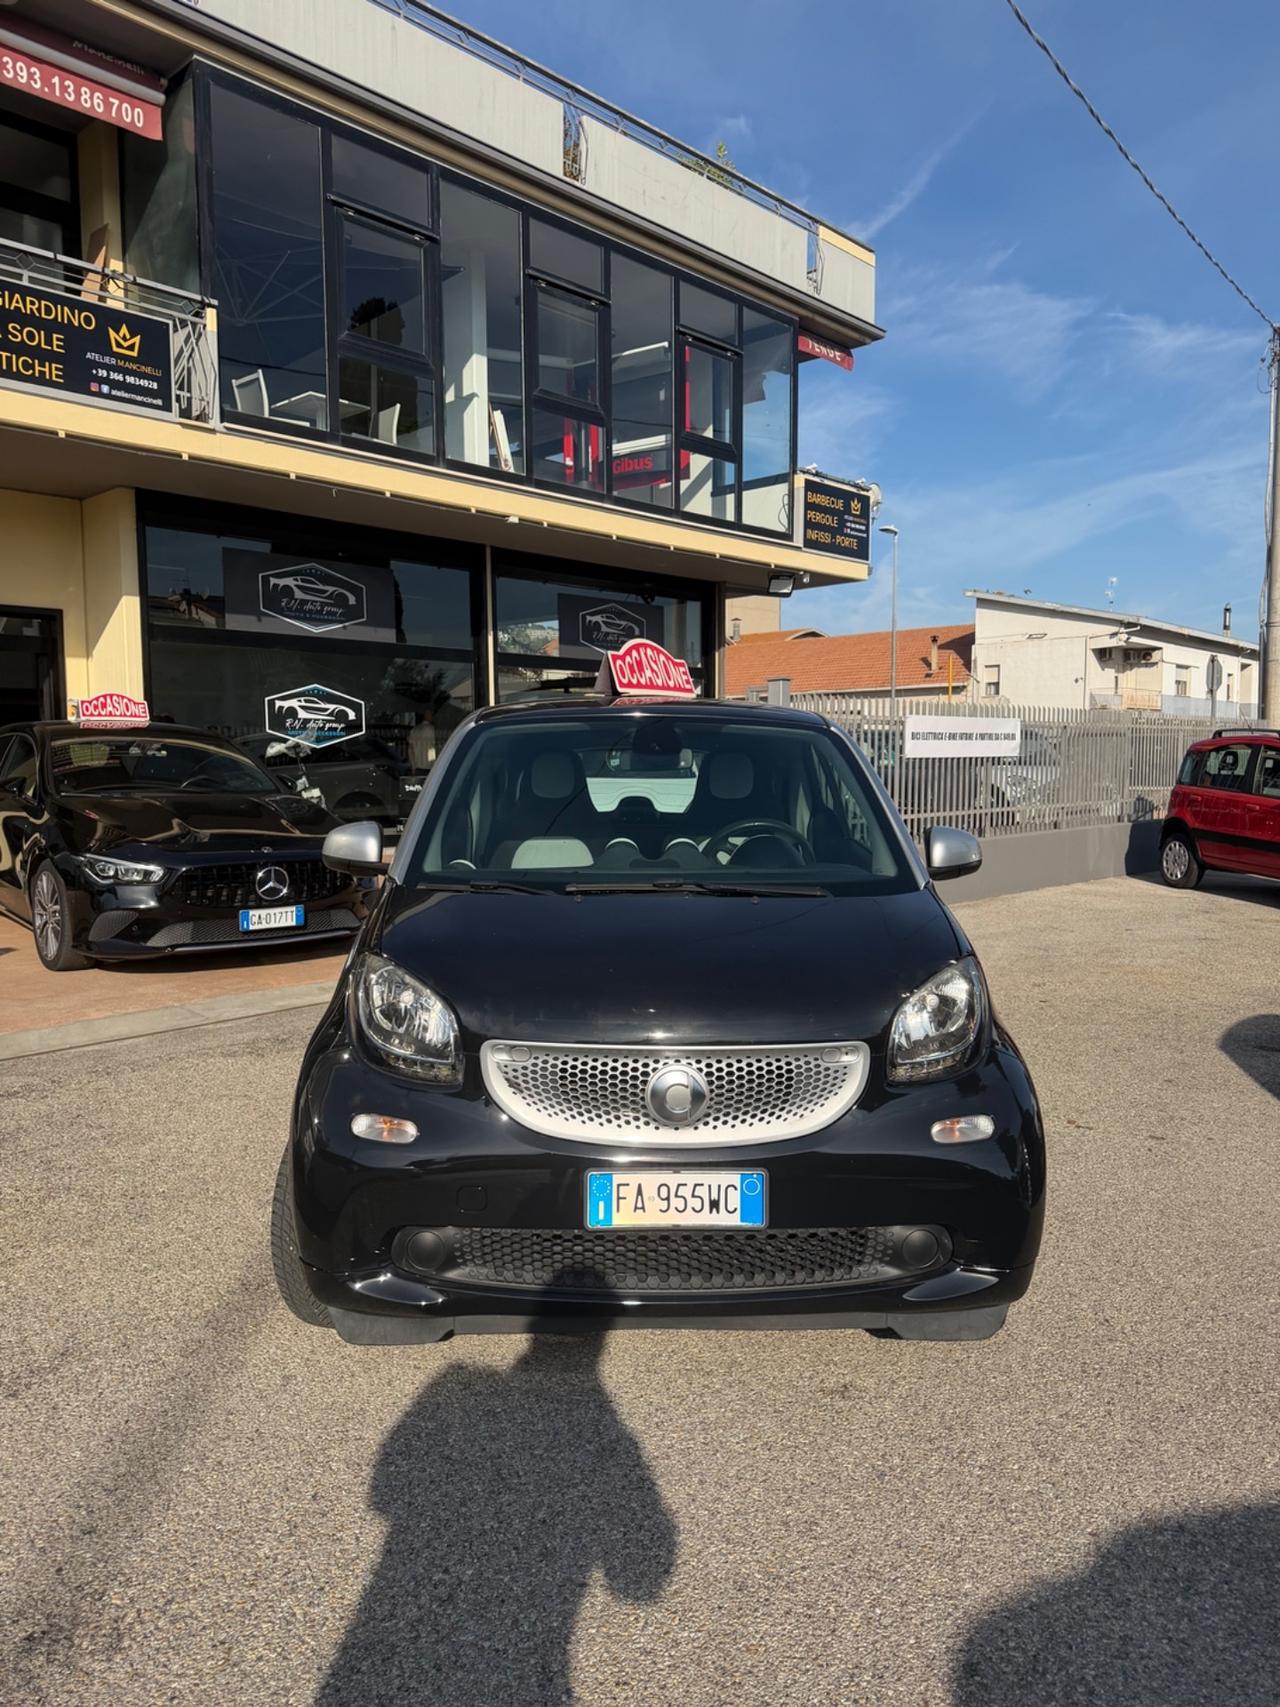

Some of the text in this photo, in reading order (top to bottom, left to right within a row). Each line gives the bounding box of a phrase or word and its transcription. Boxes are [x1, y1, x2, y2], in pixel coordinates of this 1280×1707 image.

[8, 322, 65, 354] SOLE
[85, 352, 162, 377] ATELIER MANCINELLI
[92, 368, 158, 390] +39 366 9834928
[807, 491, 844, 511] BARBECUE
[807, 510, 838, 527] PERGOLE
[806, 528, 831, 544] INFISSI
[836, 535, 858, 550] PORTE
[616, 646, 692, 689] OCCASIONE
[82, 694, 146, 717] OCCASIONE
[616, 1183, 738, 1214] FA 955WC
